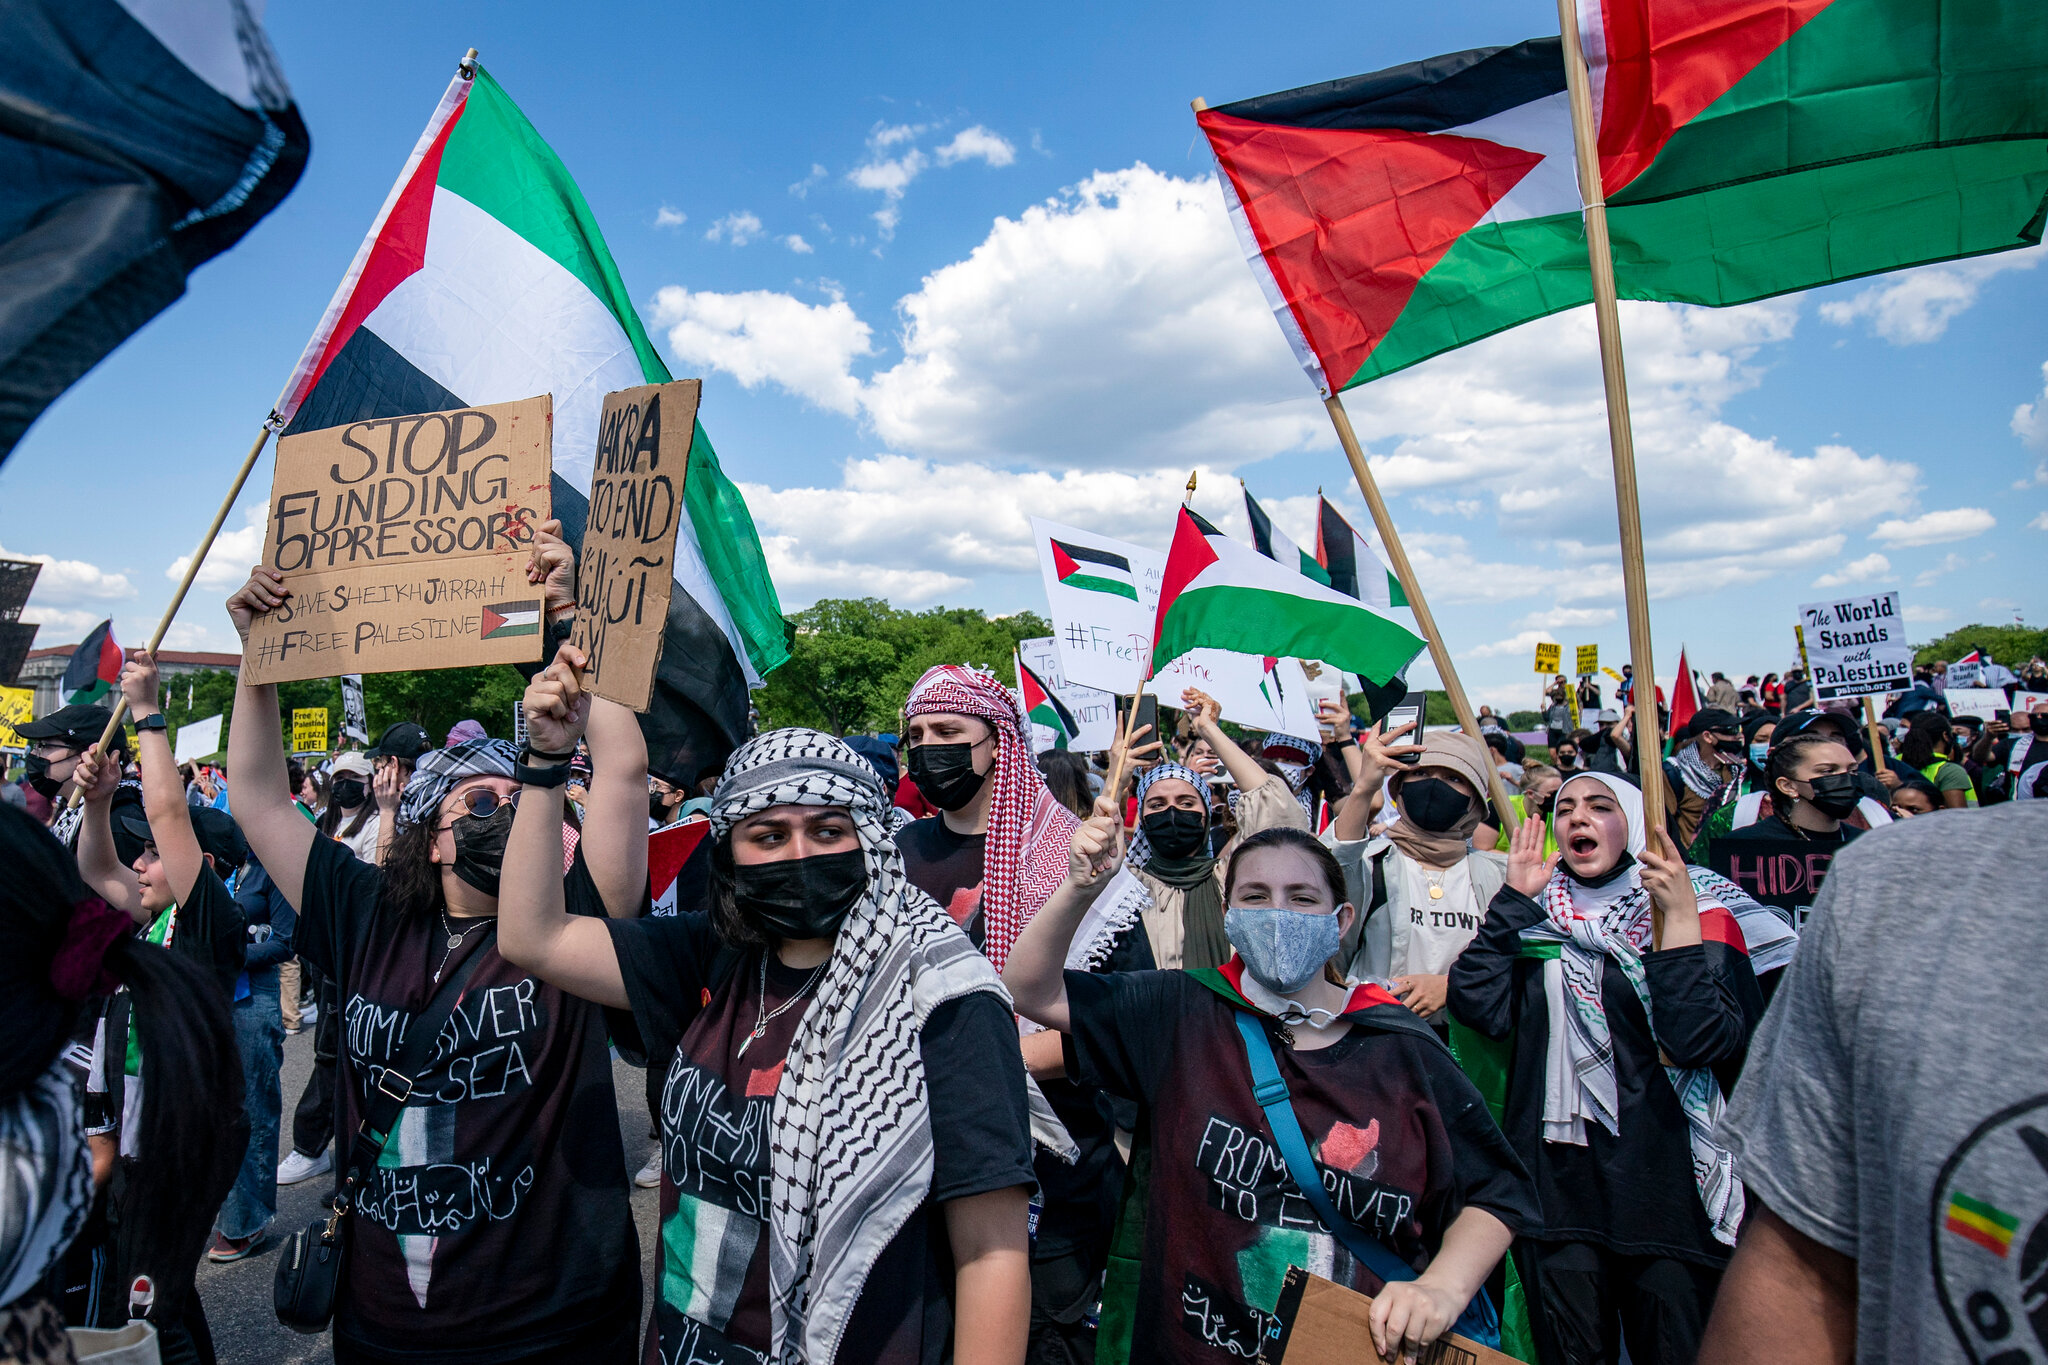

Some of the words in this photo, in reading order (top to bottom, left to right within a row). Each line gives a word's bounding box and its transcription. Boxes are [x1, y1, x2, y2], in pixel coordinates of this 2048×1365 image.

[330, 411, 498, 484] STOP
[274, 454, 510, 545] FUNDING
[274, 507, 537, 572] OPPRESSORS
[1807, 609, 1831, 628] The
[1834, 596, 1894, 623] World
[258, 630, 349, 669] #FREE
[355, 615, 480, 654] PALESTINE
[1820, 624, 1889, 649] Stands
[1843, 648, 1872, 663] with
[1813, 660, 1907, 685] Palestine
[294, 712, 311, 720] Free
[294, 721, 326, 729] Palestine
[294, 732, 306, 740] LET
[308, 731, 326, 739] GAZA
[298, 740, 322, 751] LIVE!
[436, 1041, 533, 1104] SEA
[1214, 1178, 1258, 1222] TO
